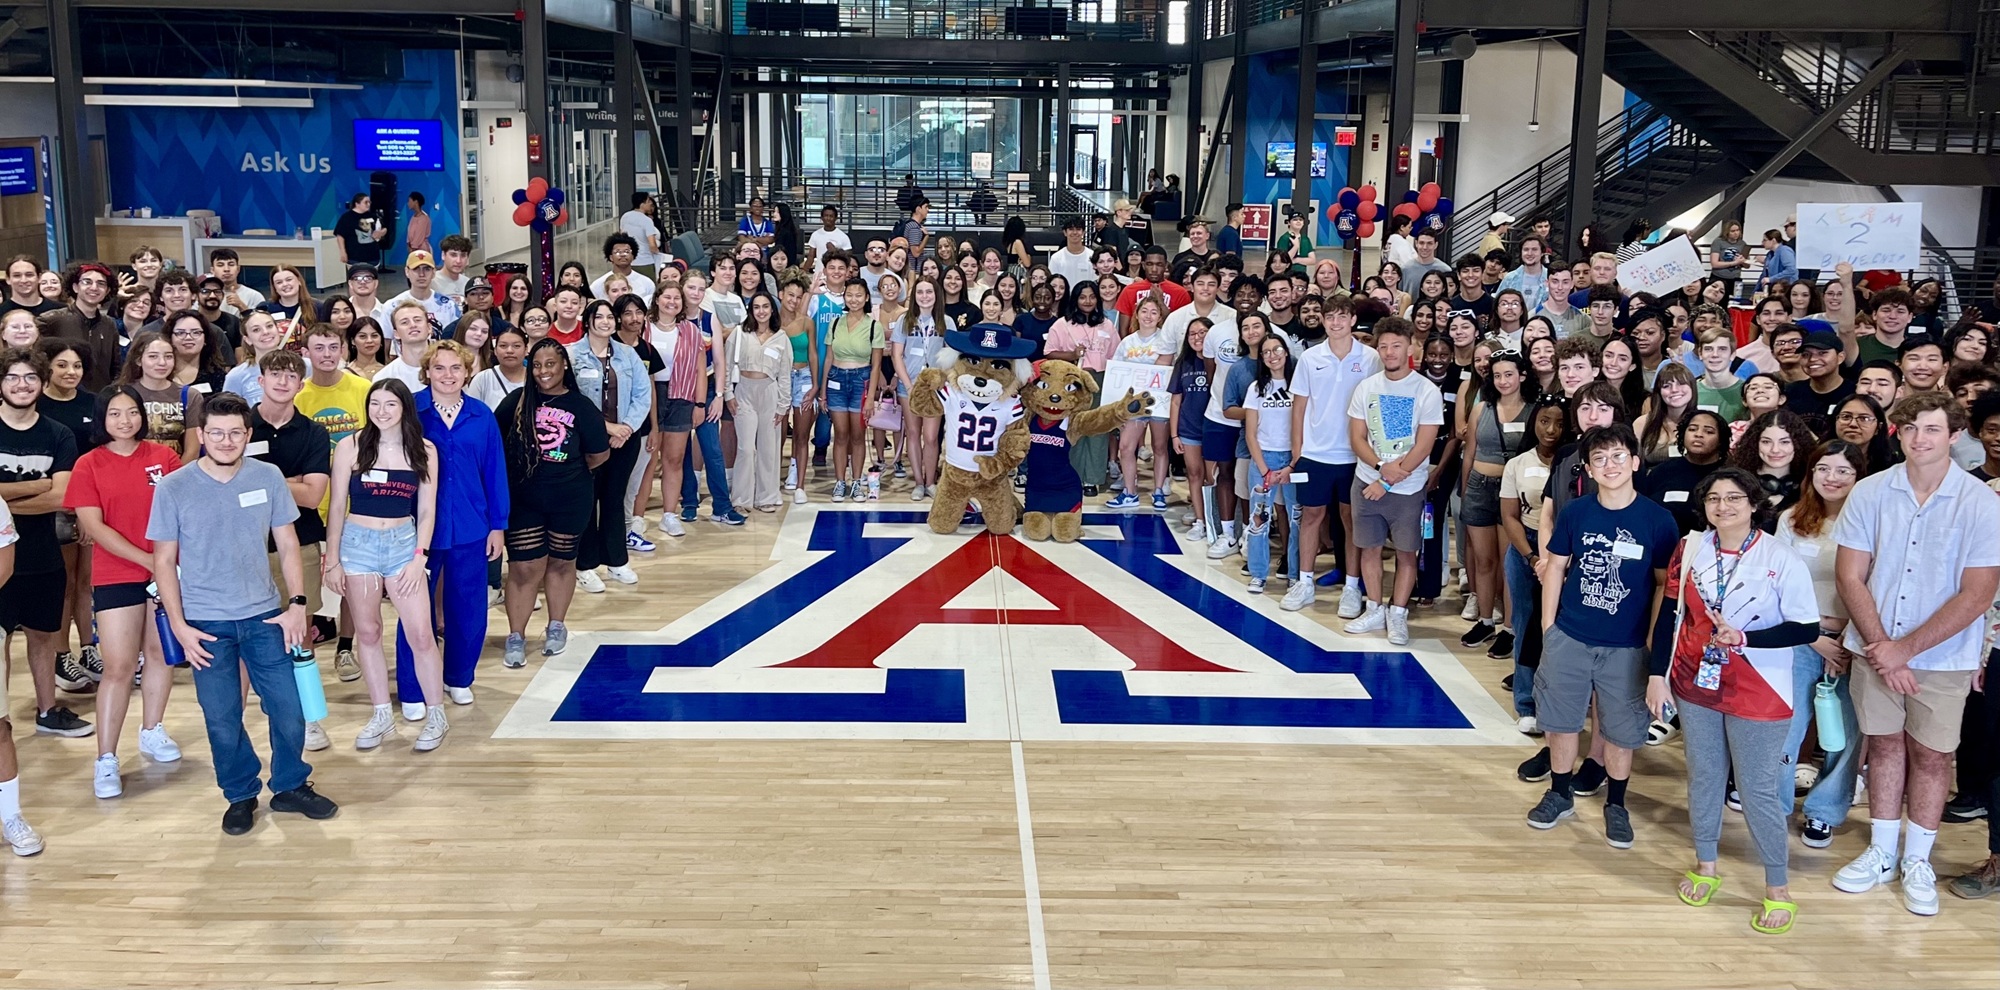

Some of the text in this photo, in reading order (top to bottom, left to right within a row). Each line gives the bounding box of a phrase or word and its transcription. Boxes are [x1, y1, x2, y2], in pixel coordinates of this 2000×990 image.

[586, 112, 617, 122] Writing
[240, 151, 331, 174] Ask Us
[1338, 216, 1353, 230] A
[1845, 222, 1870, 245] 2
[981, 330, 998, 348] A
[1351, 363, 1362, 373] A
[1110, 366, 1173, 392] TEA
[1262, 400, 1294, 408] adida
[957, 412, 997, 452] 22
[1029, 434, 1064, 448] RIZONA
[1582, 594, 1618, 615] string
